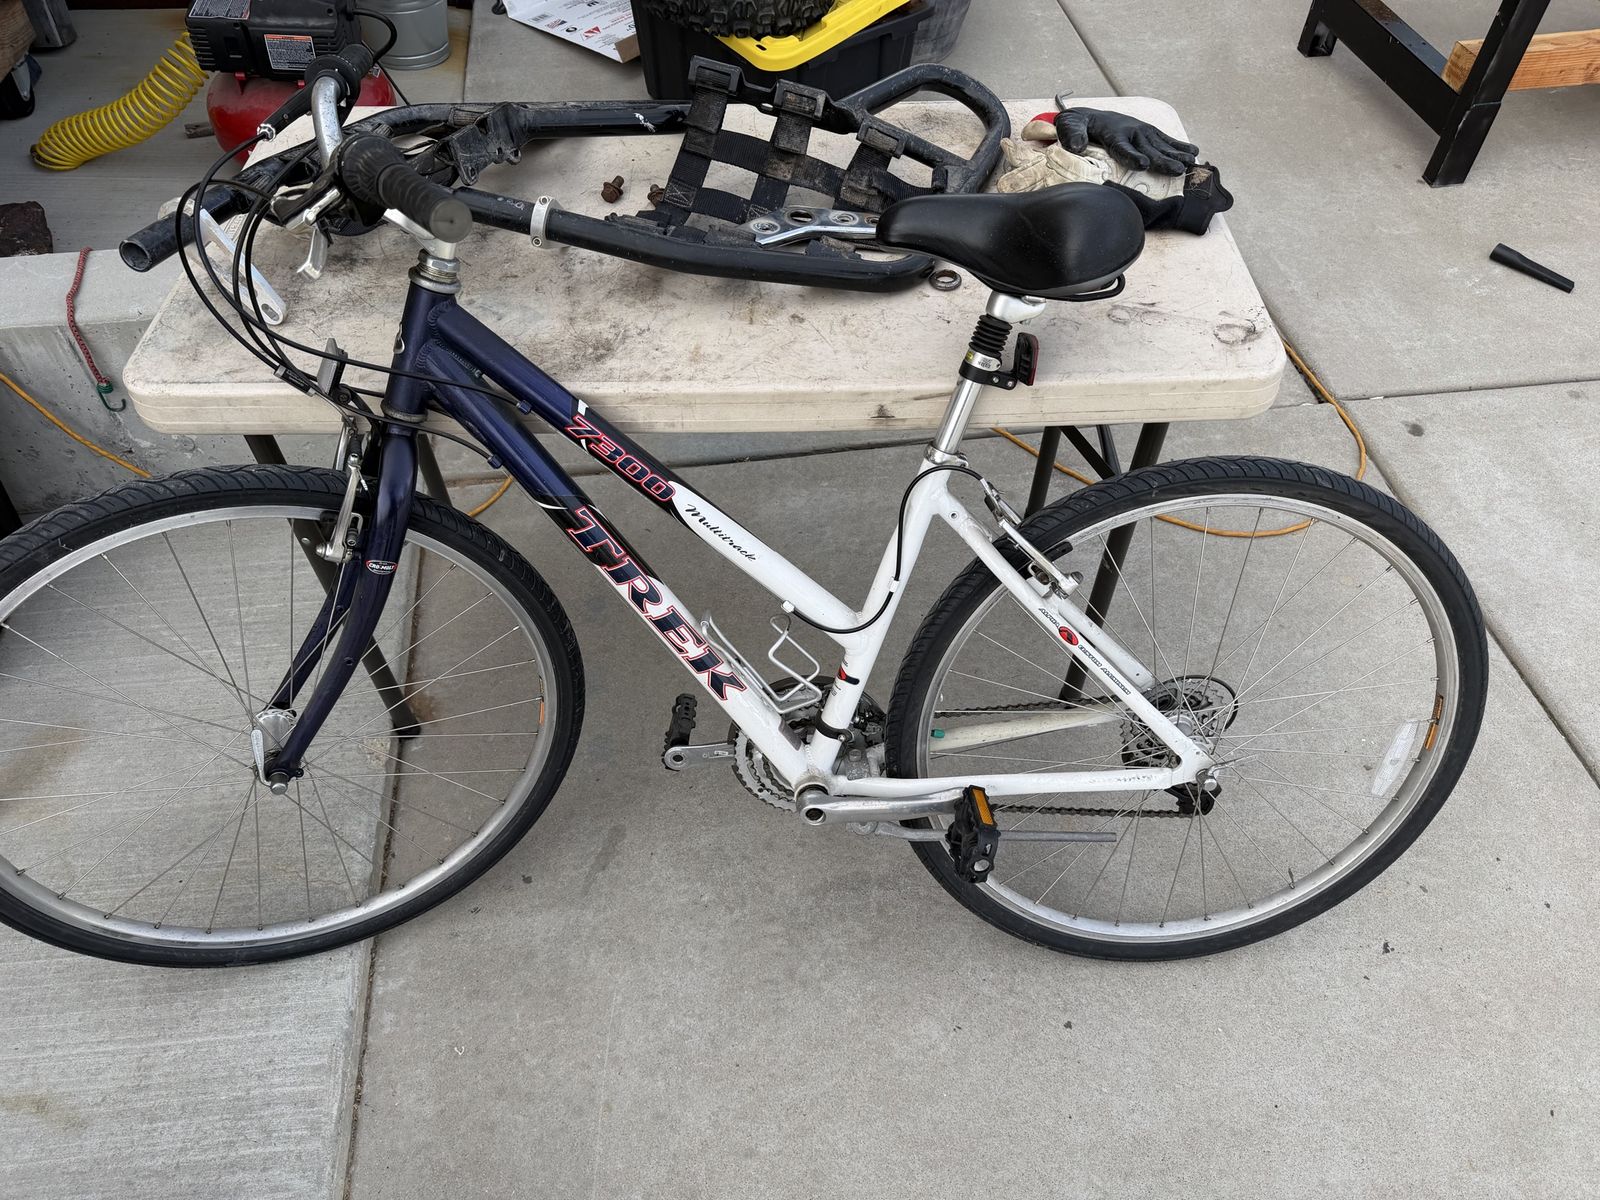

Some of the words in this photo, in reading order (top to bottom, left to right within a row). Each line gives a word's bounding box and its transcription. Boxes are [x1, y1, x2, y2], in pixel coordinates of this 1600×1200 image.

[565, 415, 676, 501] 7300
[685, 504, 757, 561] Multitrack
[568, 508, 747, 700] TREK
